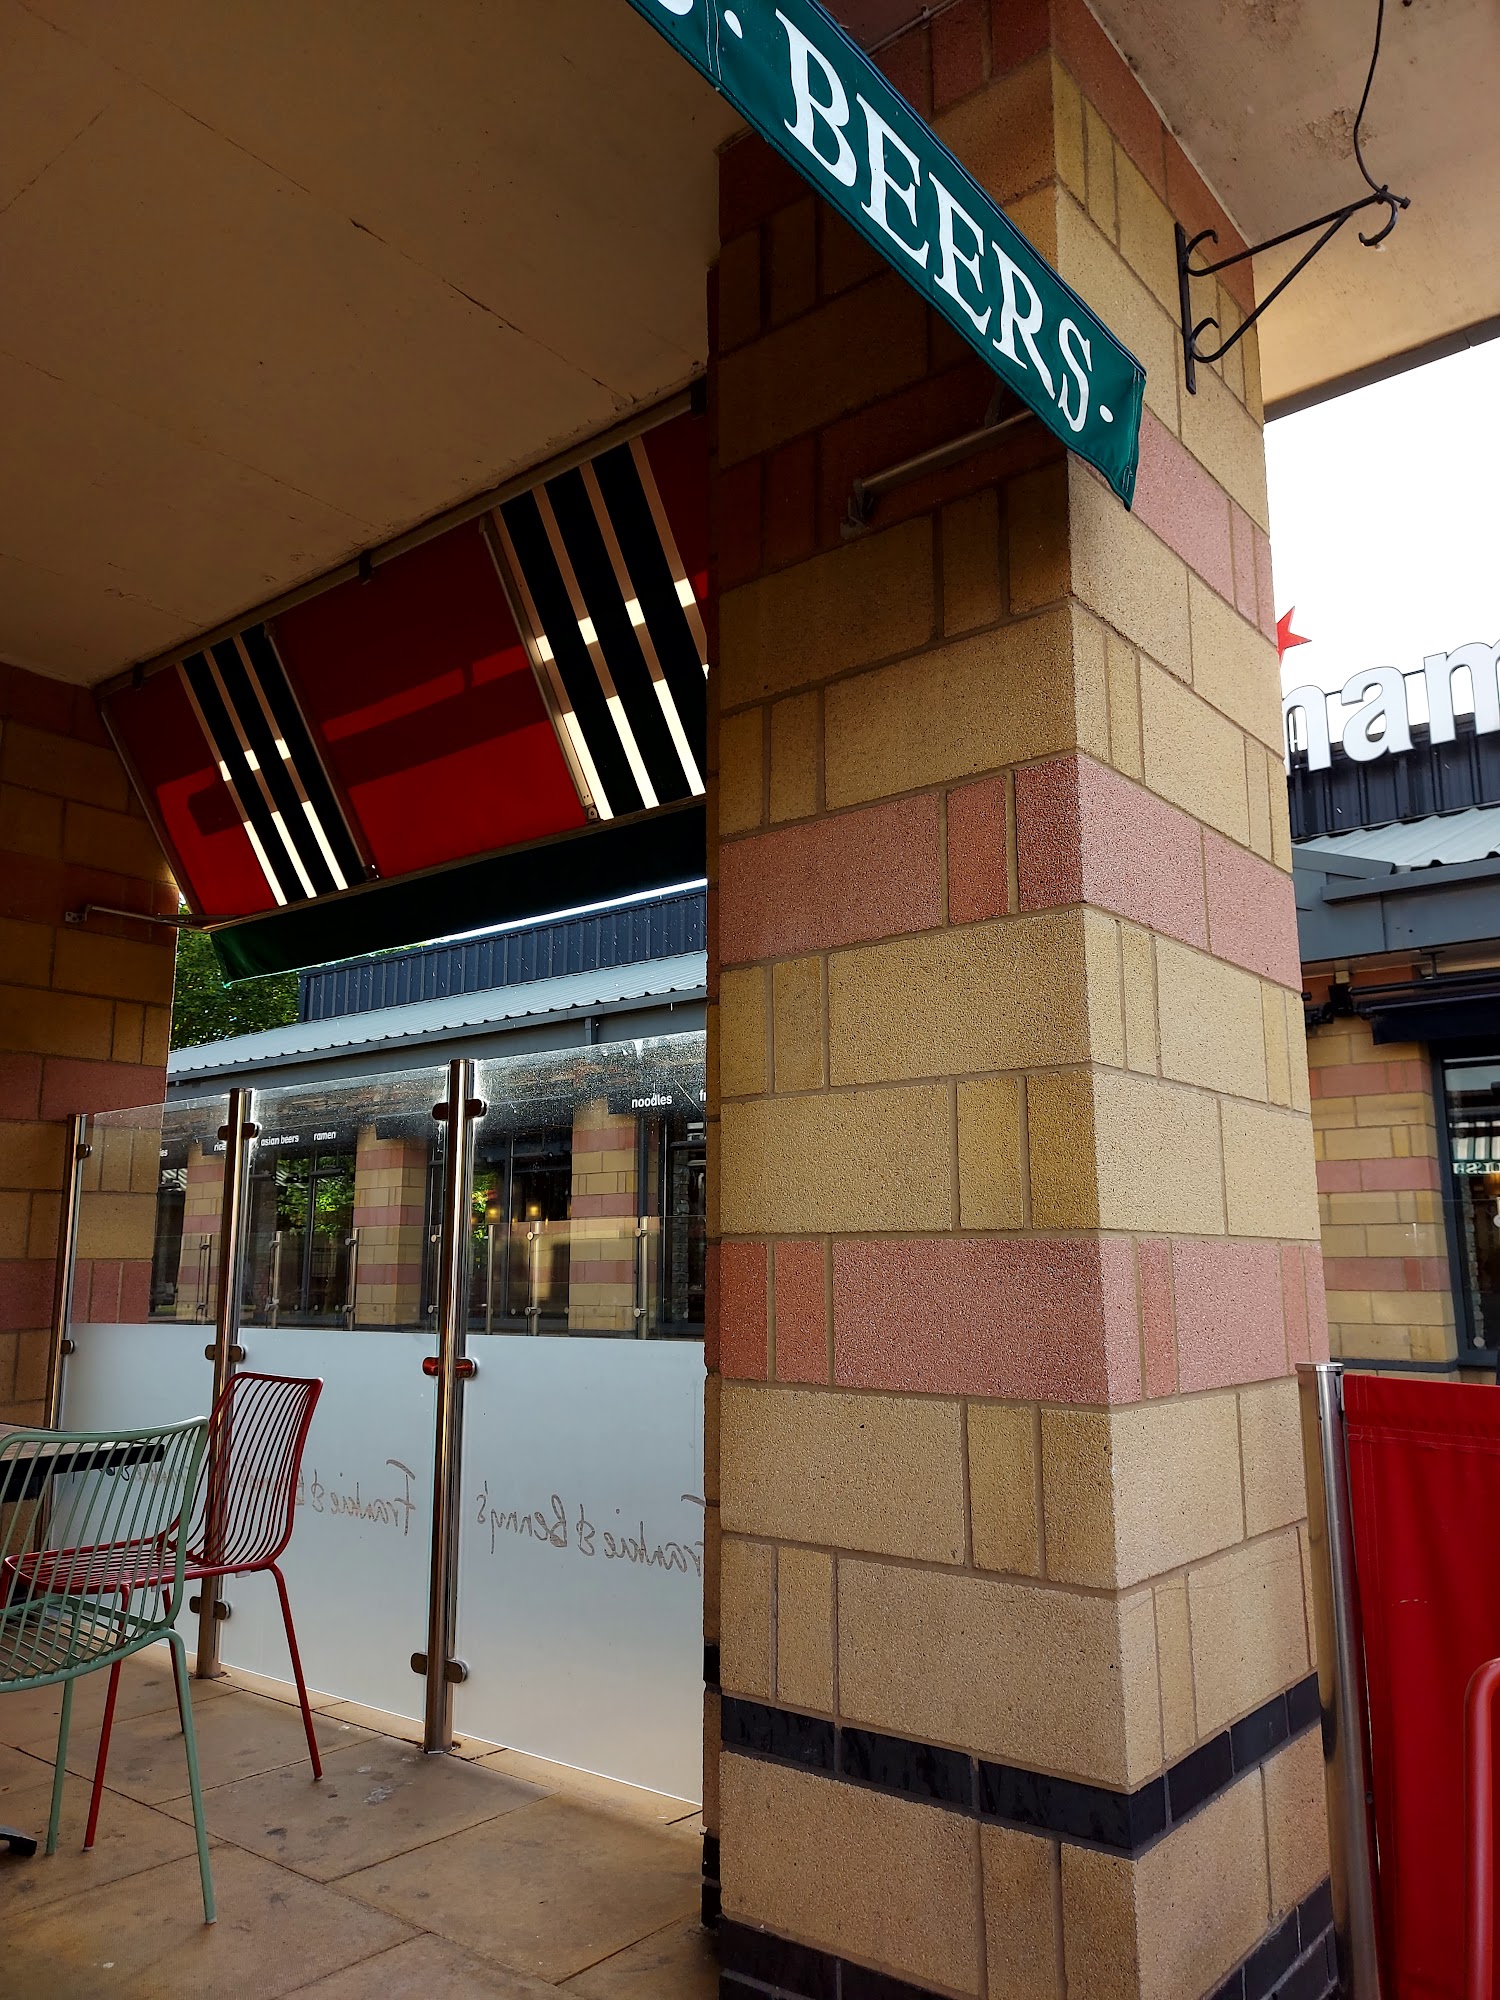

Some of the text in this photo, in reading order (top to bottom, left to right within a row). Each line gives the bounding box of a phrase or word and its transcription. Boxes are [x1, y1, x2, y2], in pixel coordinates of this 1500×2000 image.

[631, 1093, 673, 1108] noodles
[260, 1134, 299, 1147] asian beers
[313, 1131, 337, 1141] ramen
